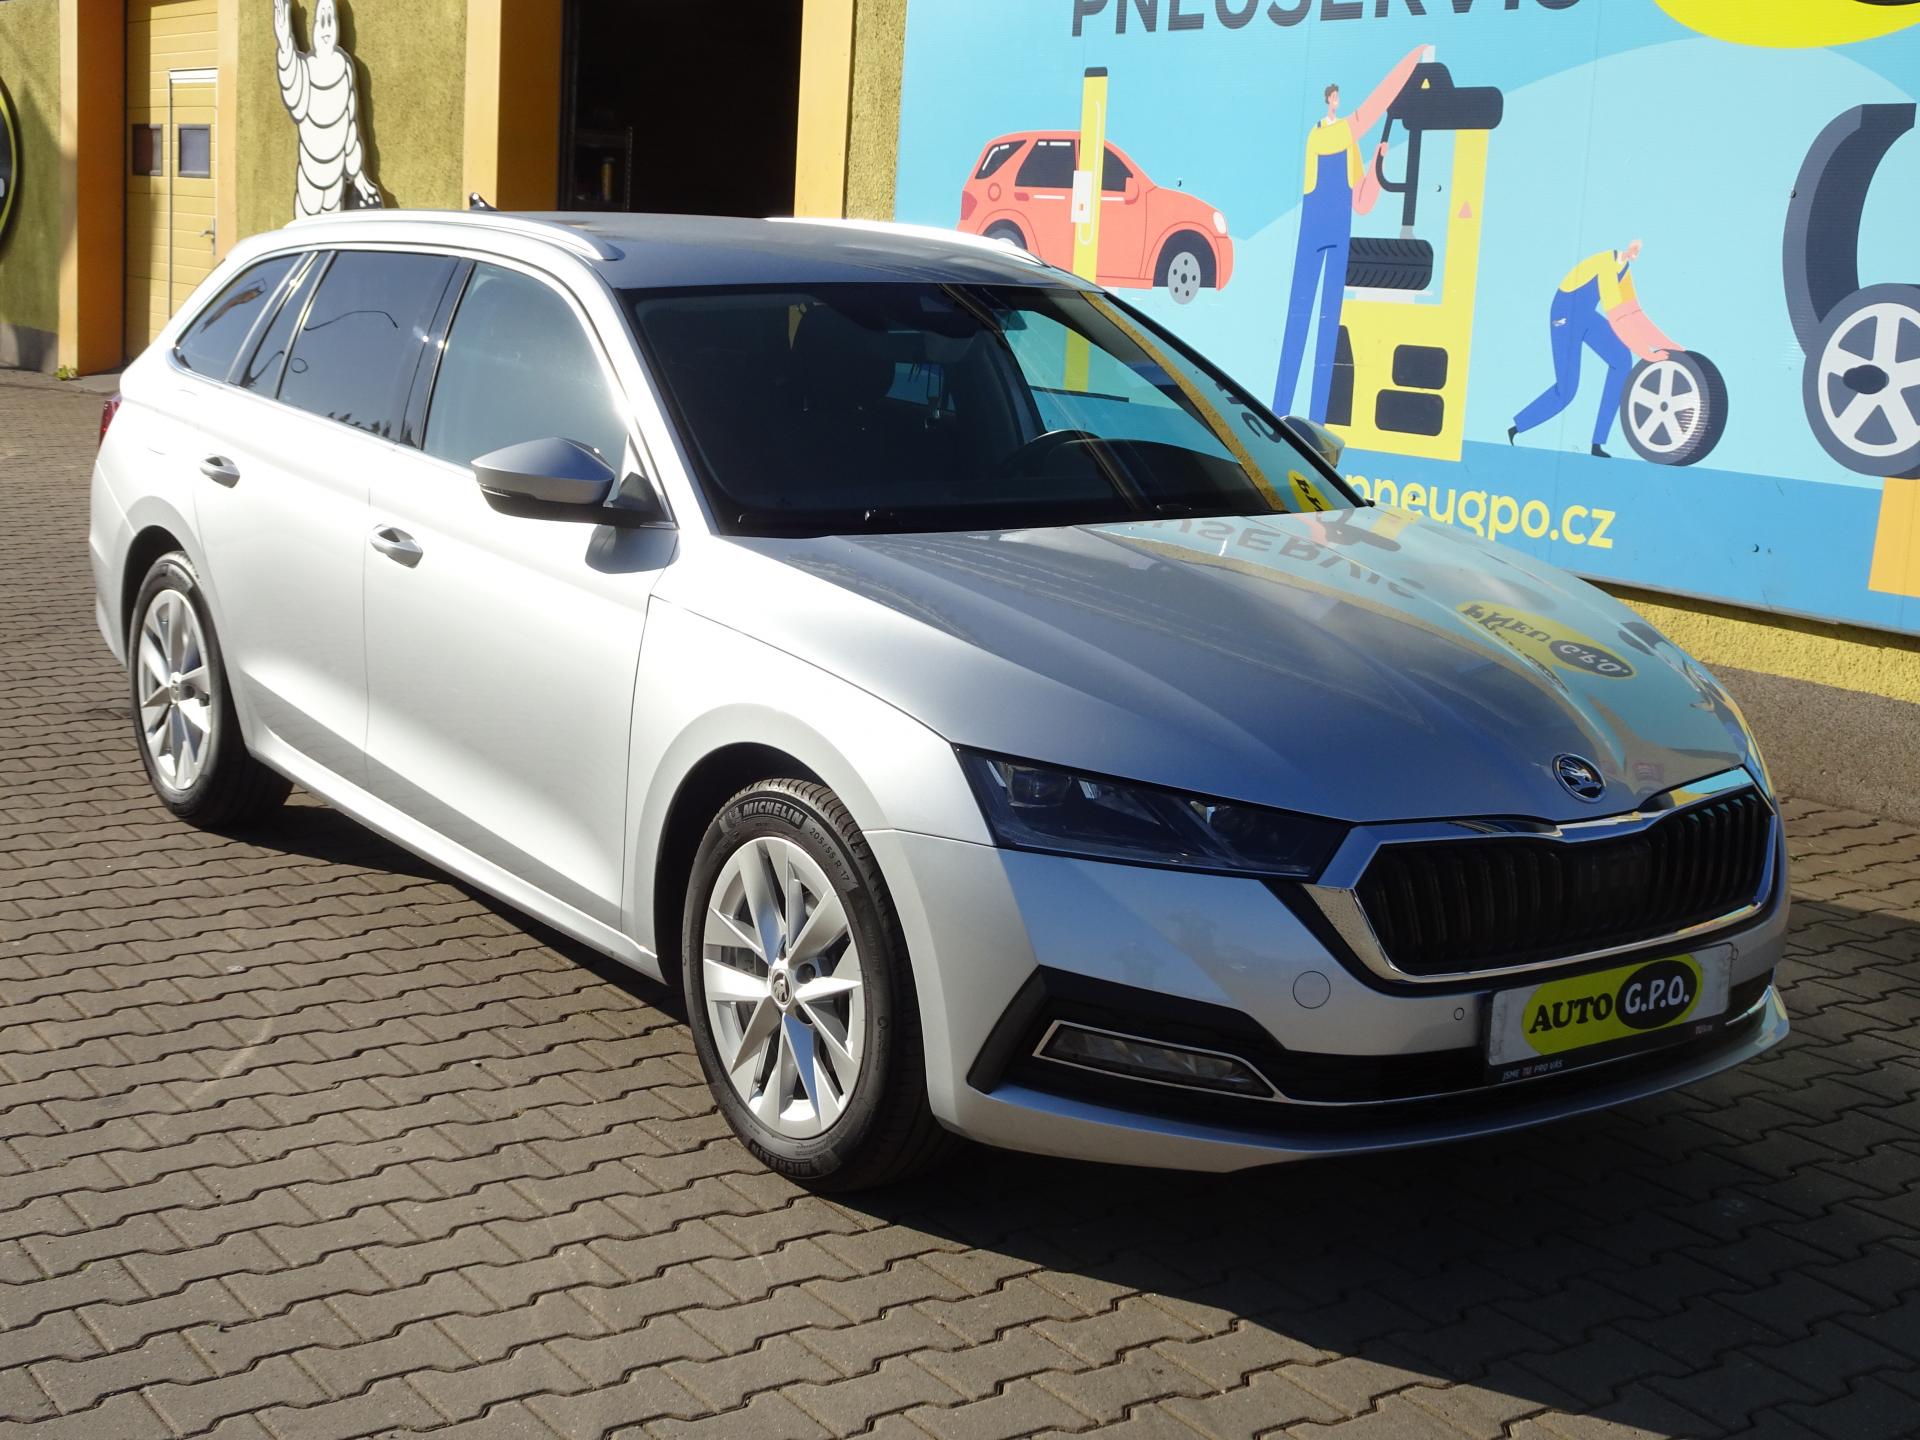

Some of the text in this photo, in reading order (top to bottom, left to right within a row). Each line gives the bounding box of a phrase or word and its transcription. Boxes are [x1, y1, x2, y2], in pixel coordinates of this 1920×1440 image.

[743, 801, 804, 826] MICHELIN
[809, 828, 837, 860] 205/55
[840, 870, 850, 881] 17
[1528, 975, 1690, 1034] AUTO G.P.O.
